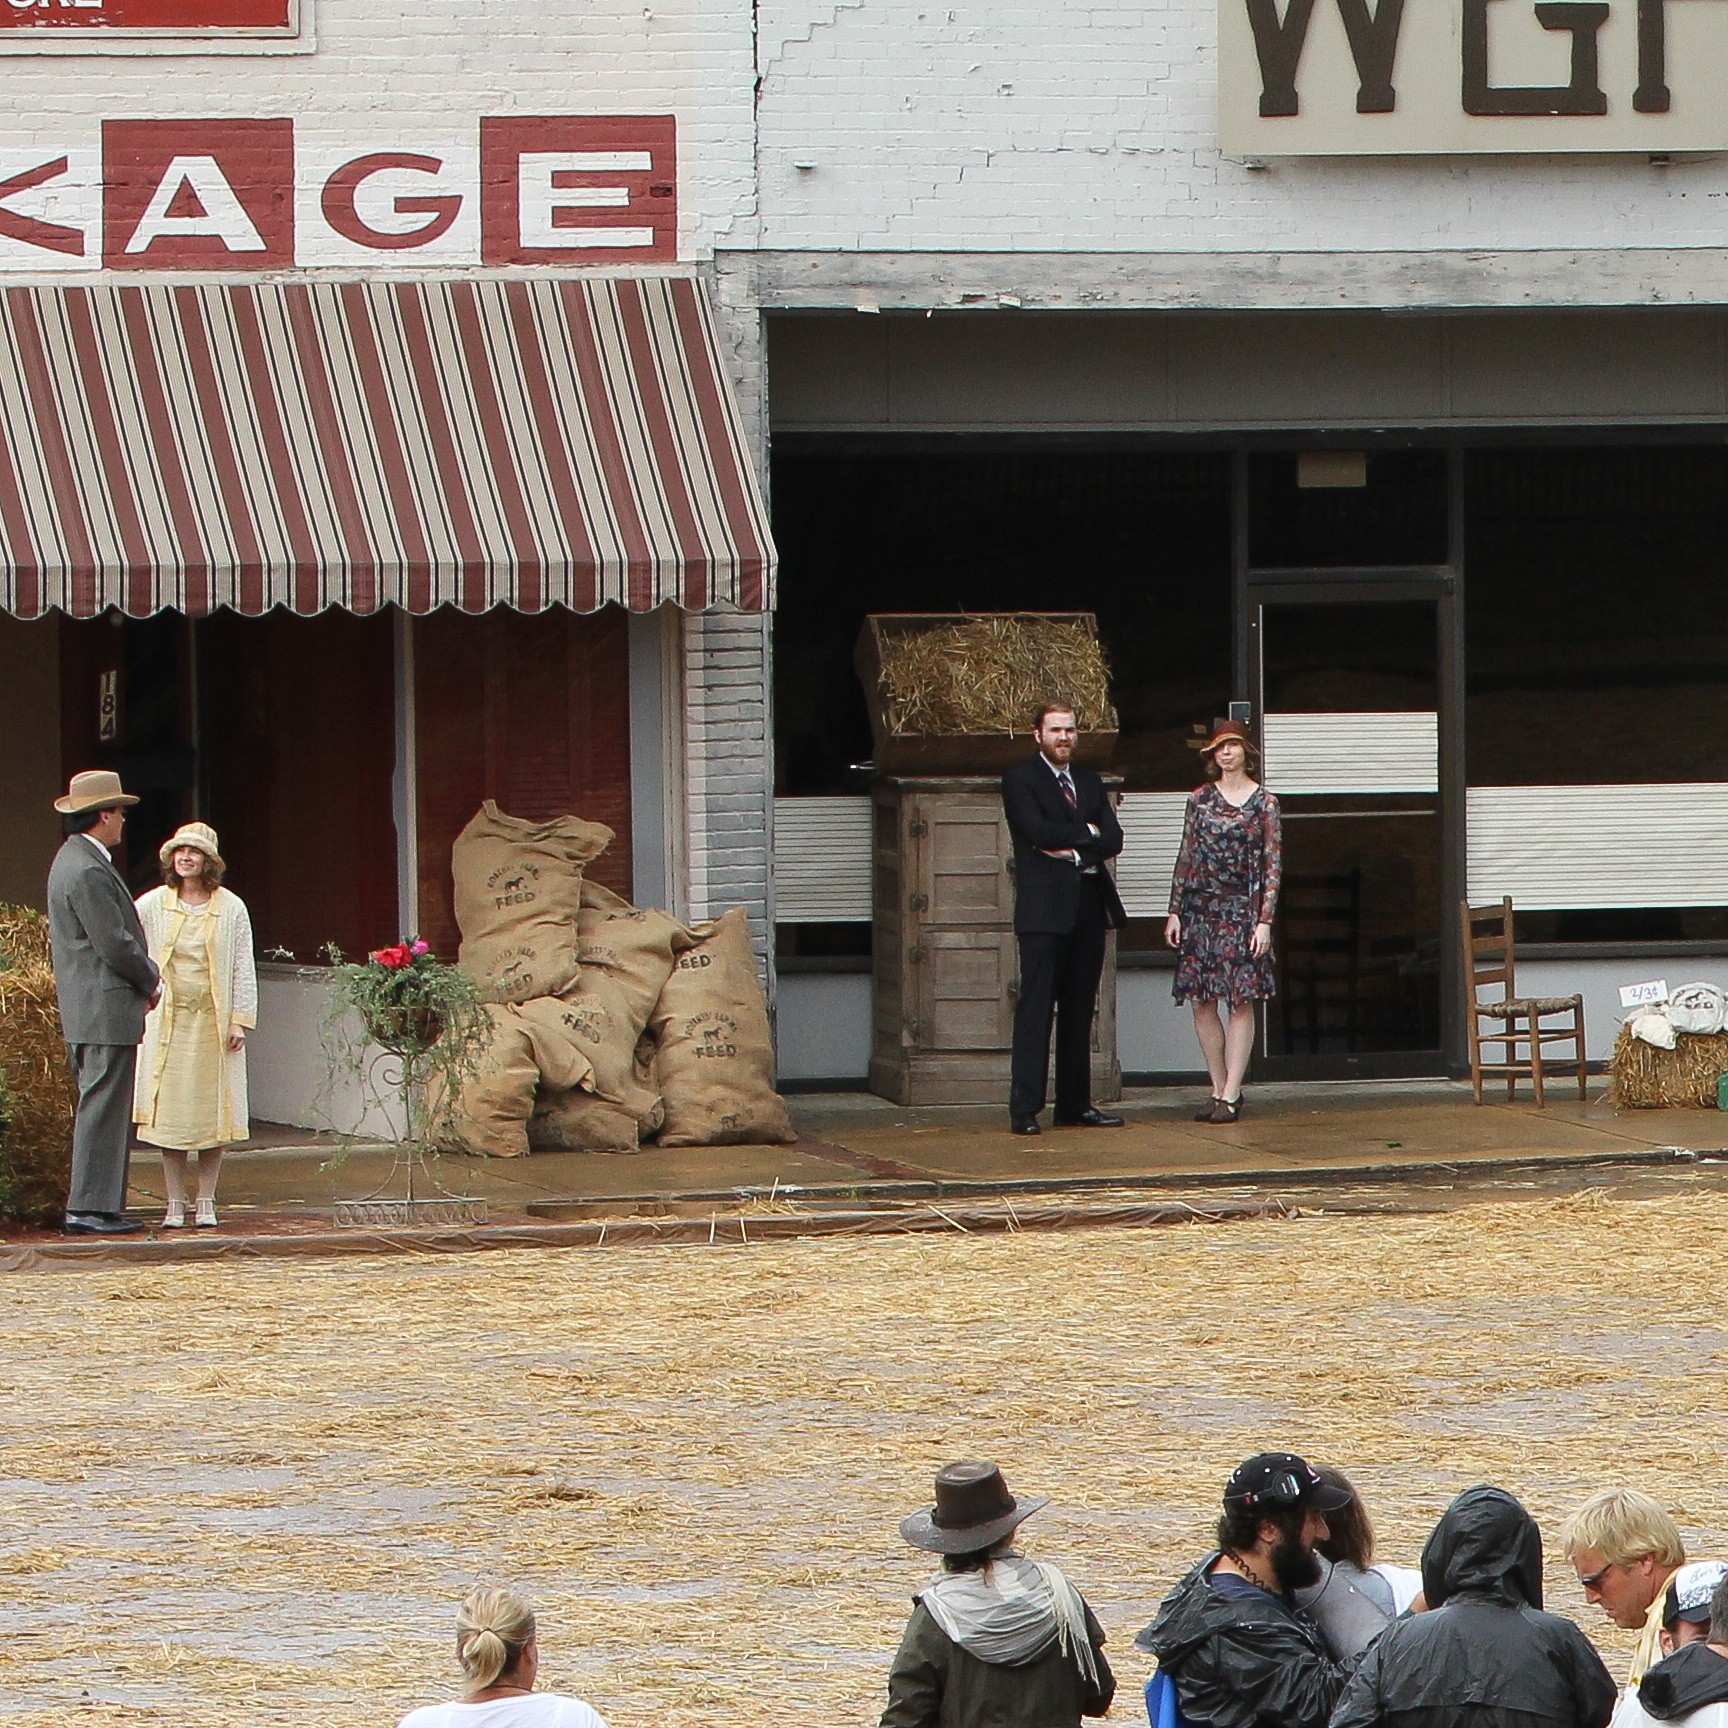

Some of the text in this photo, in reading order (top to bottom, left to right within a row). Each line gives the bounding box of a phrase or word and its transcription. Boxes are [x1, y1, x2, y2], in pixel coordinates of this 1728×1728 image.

[495, 891, 536, 910] FEED
[677, 954, 711, 970] EED
[695, 1043, 737, 1058] FEED
